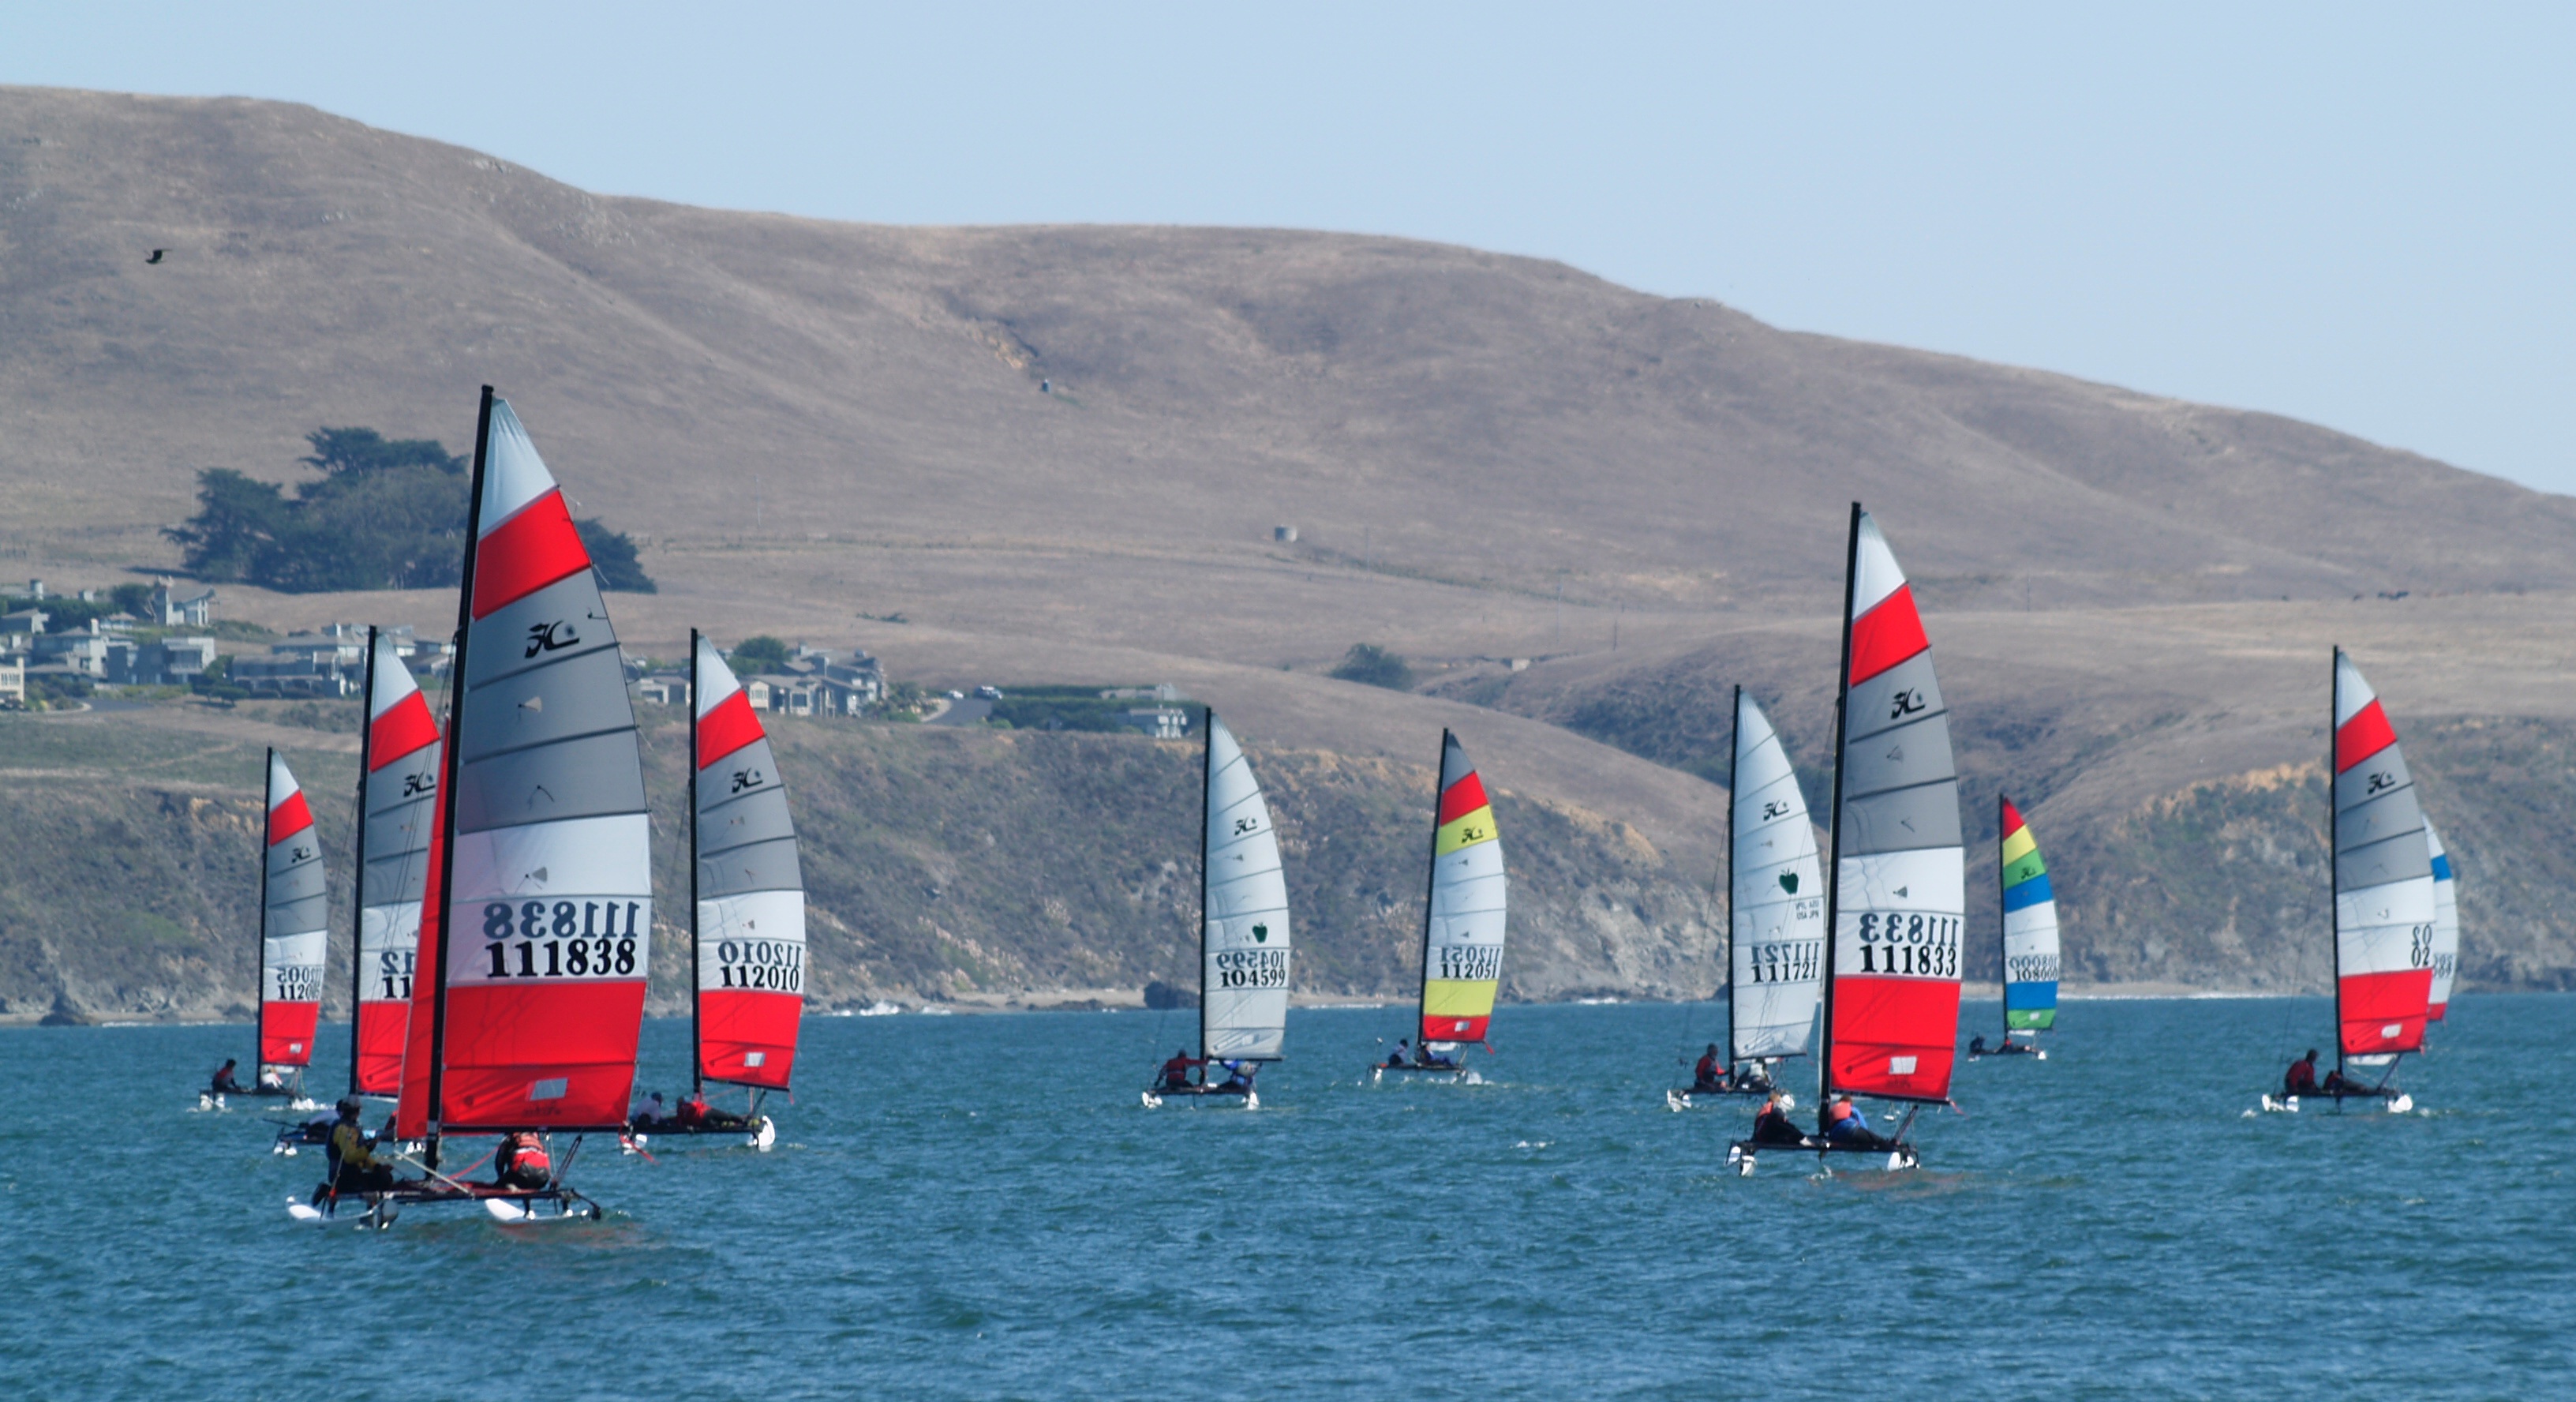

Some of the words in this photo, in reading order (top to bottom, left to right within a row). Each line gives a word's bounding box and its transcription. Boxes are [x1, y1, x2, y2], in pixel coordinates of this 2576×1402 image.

[485, 938, 636, 977] 111838
[1859, 944, 1956, 977] 111833
[2411, 946, 2430, 968] 02
[720, 965, 799, 992] 112010
[1220, 969, 1286, 988] 104599
[1440, 962, 1496, 979] 112051
[1751, 961, 1817, 983] 111721
